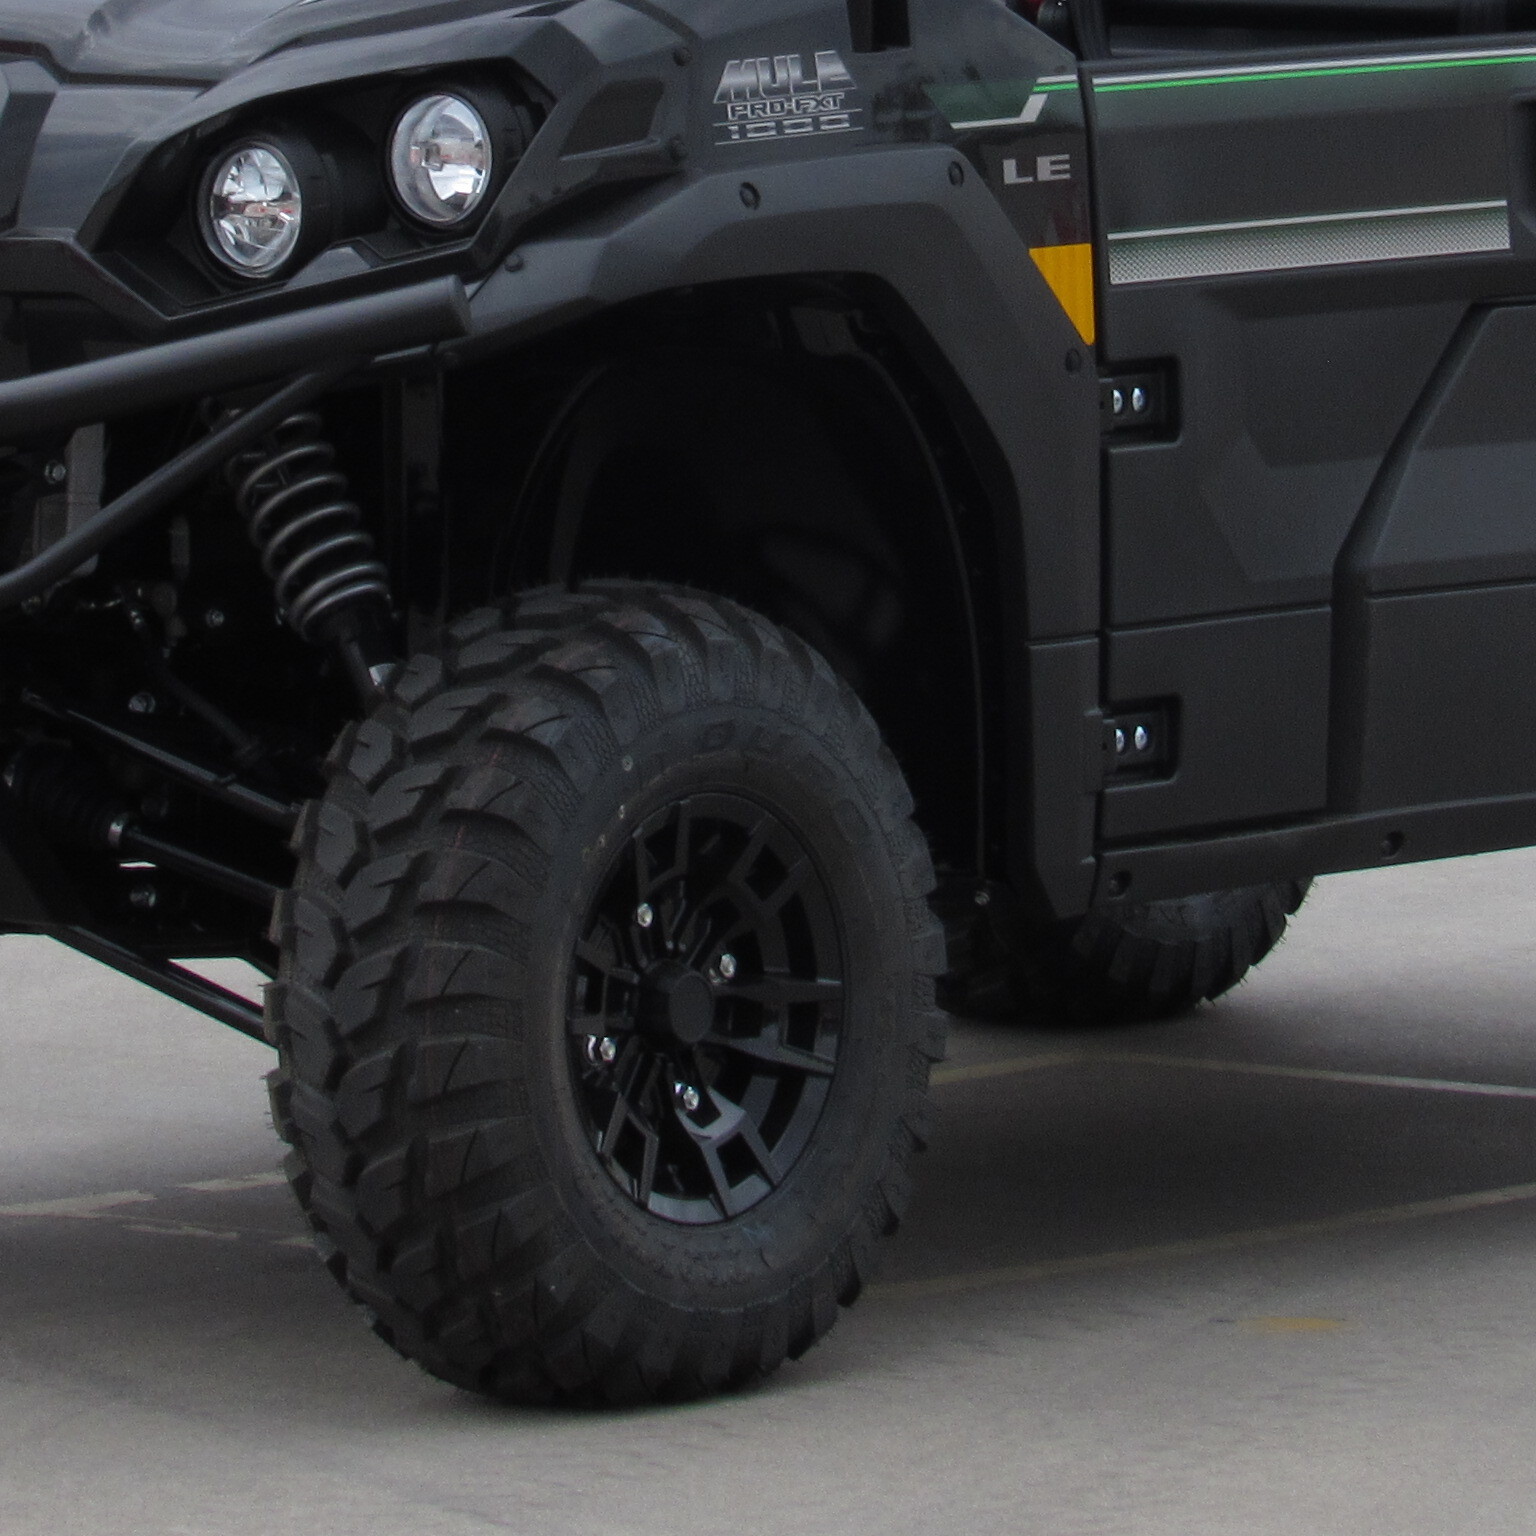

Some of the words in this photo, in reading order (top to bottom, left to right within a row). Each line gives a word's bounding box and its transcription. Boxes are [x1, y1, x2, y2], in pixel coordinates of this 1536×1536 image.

[714, 50, 857, 103] MULE
[727, 114, 851, 139] 1000
[1003, 154, 1071, 184] LE
